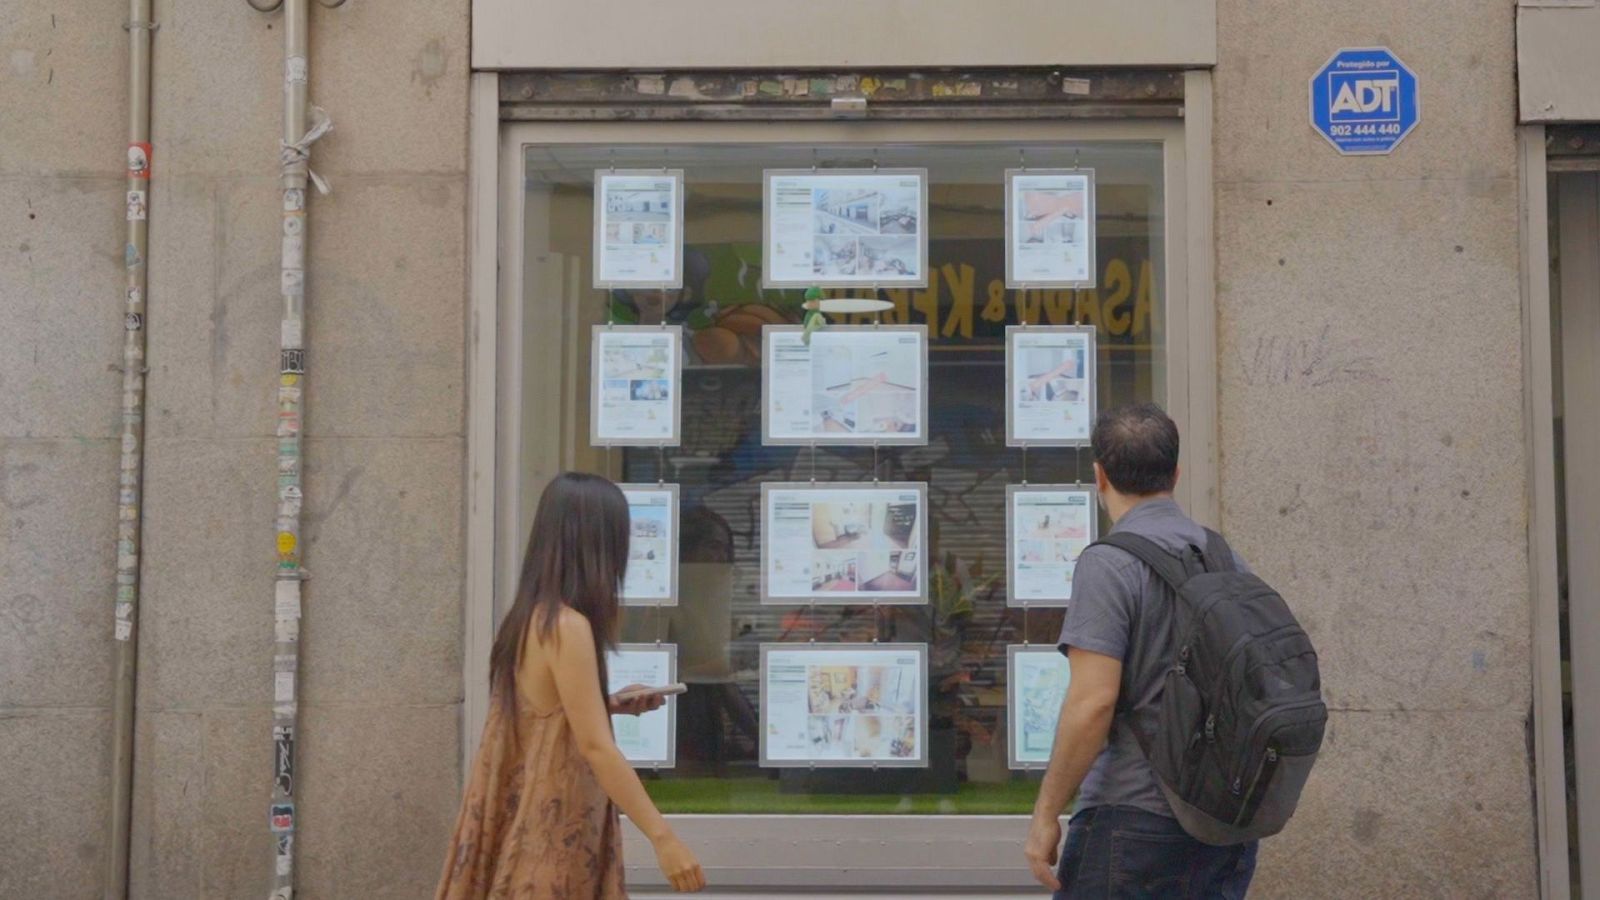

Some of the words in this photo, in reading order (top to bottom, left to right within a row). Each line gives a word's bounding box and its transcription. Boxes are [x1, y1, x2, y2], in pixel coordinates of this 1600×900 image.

[1337, 60, 1375, 69] Protegido
[1376, 60, 1390, 68] por
[1332, 79, 1398, 113] ADT
[1330, 125, 1352, 136] 902
[1354, 124, 1376, 135] 444
[1378, 123, 1400, 135] 440
